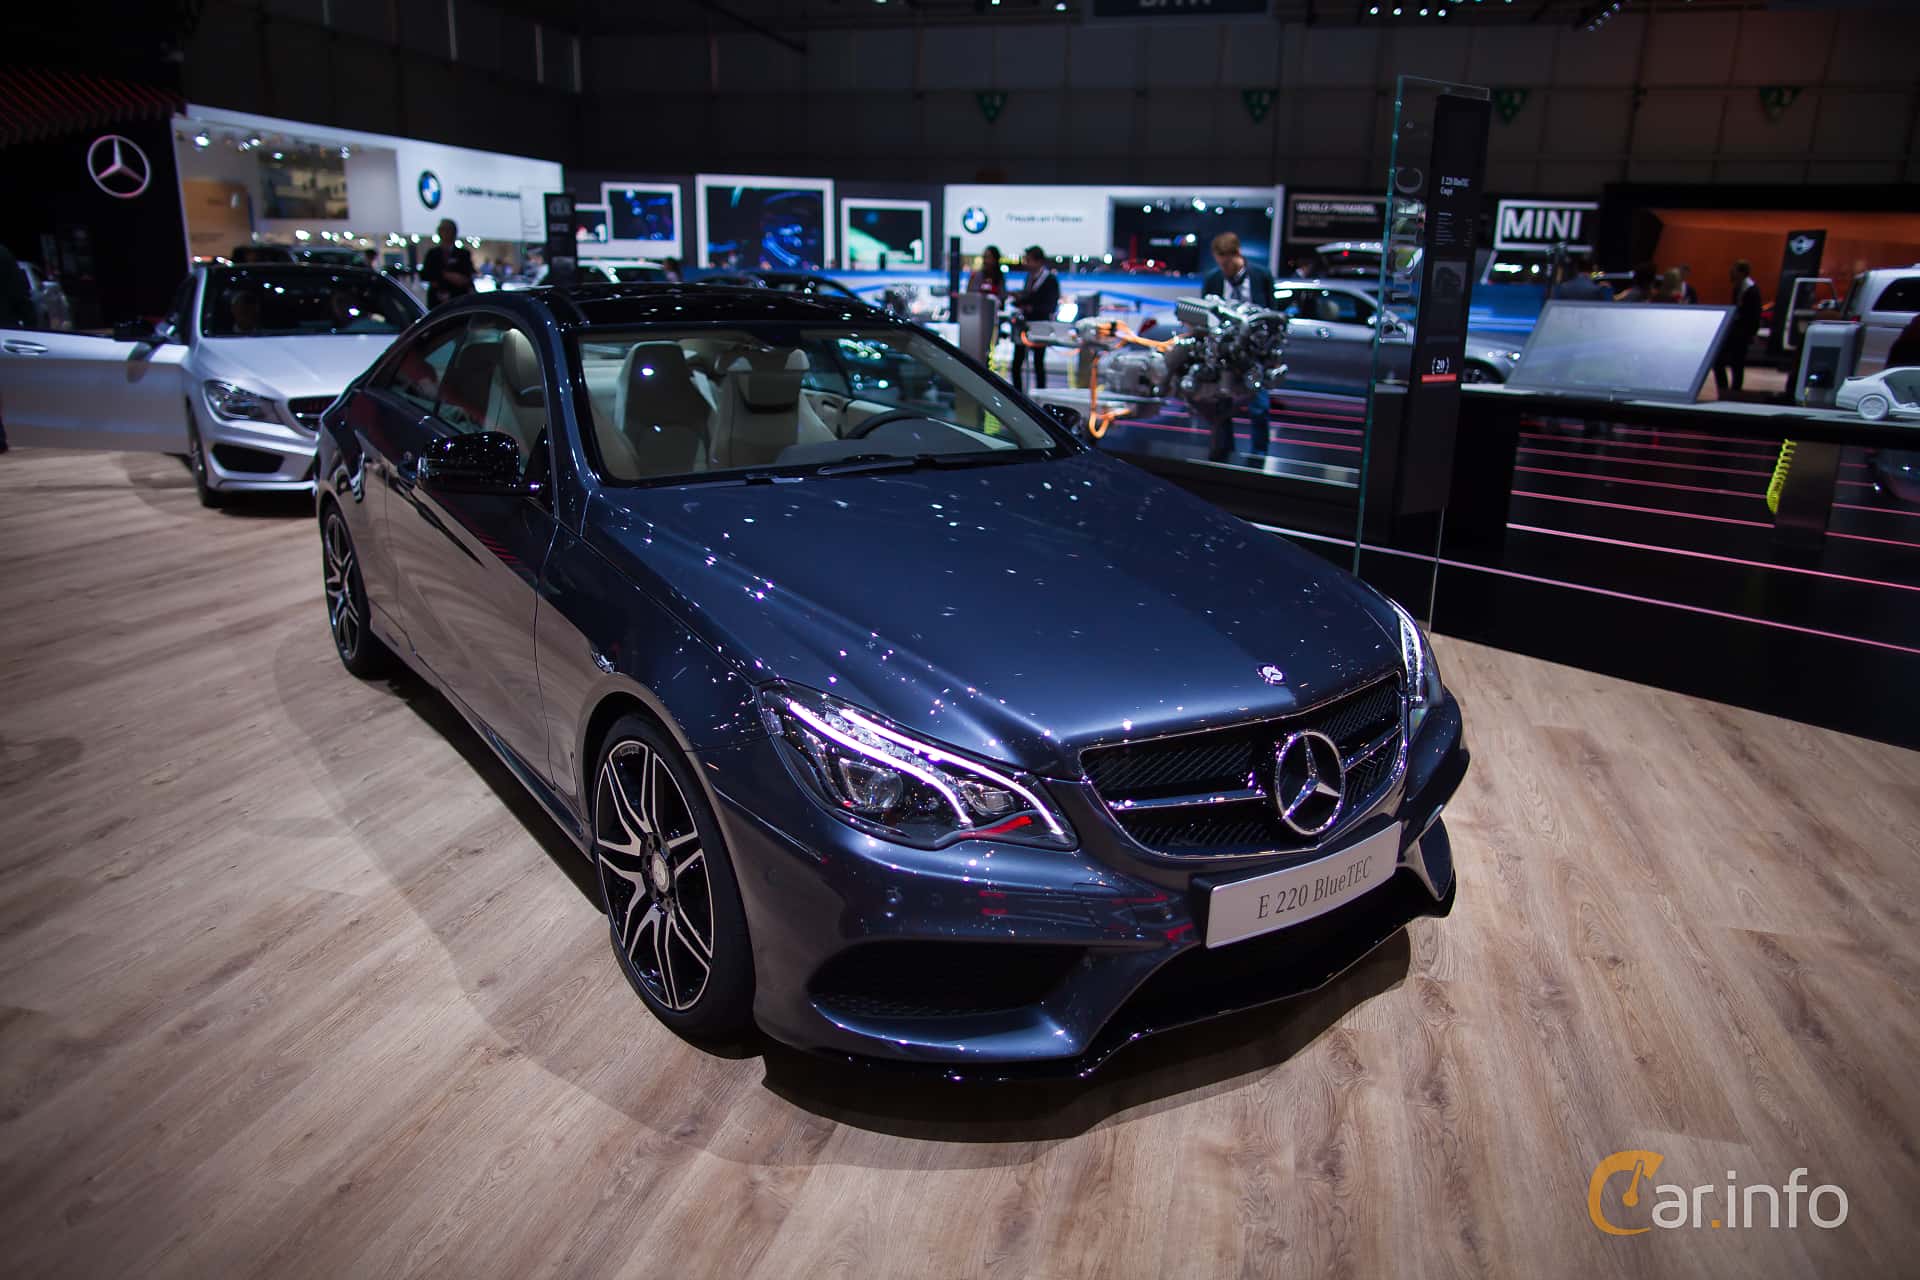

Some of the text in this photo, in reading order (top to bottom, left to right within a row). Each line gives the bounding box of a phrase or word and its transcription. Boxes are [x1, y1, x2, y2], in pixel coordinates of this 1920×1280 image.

[1503, 208, 1582, 238] MINI
[1257, 856, 1372, 920] E 220 BlueTEC
